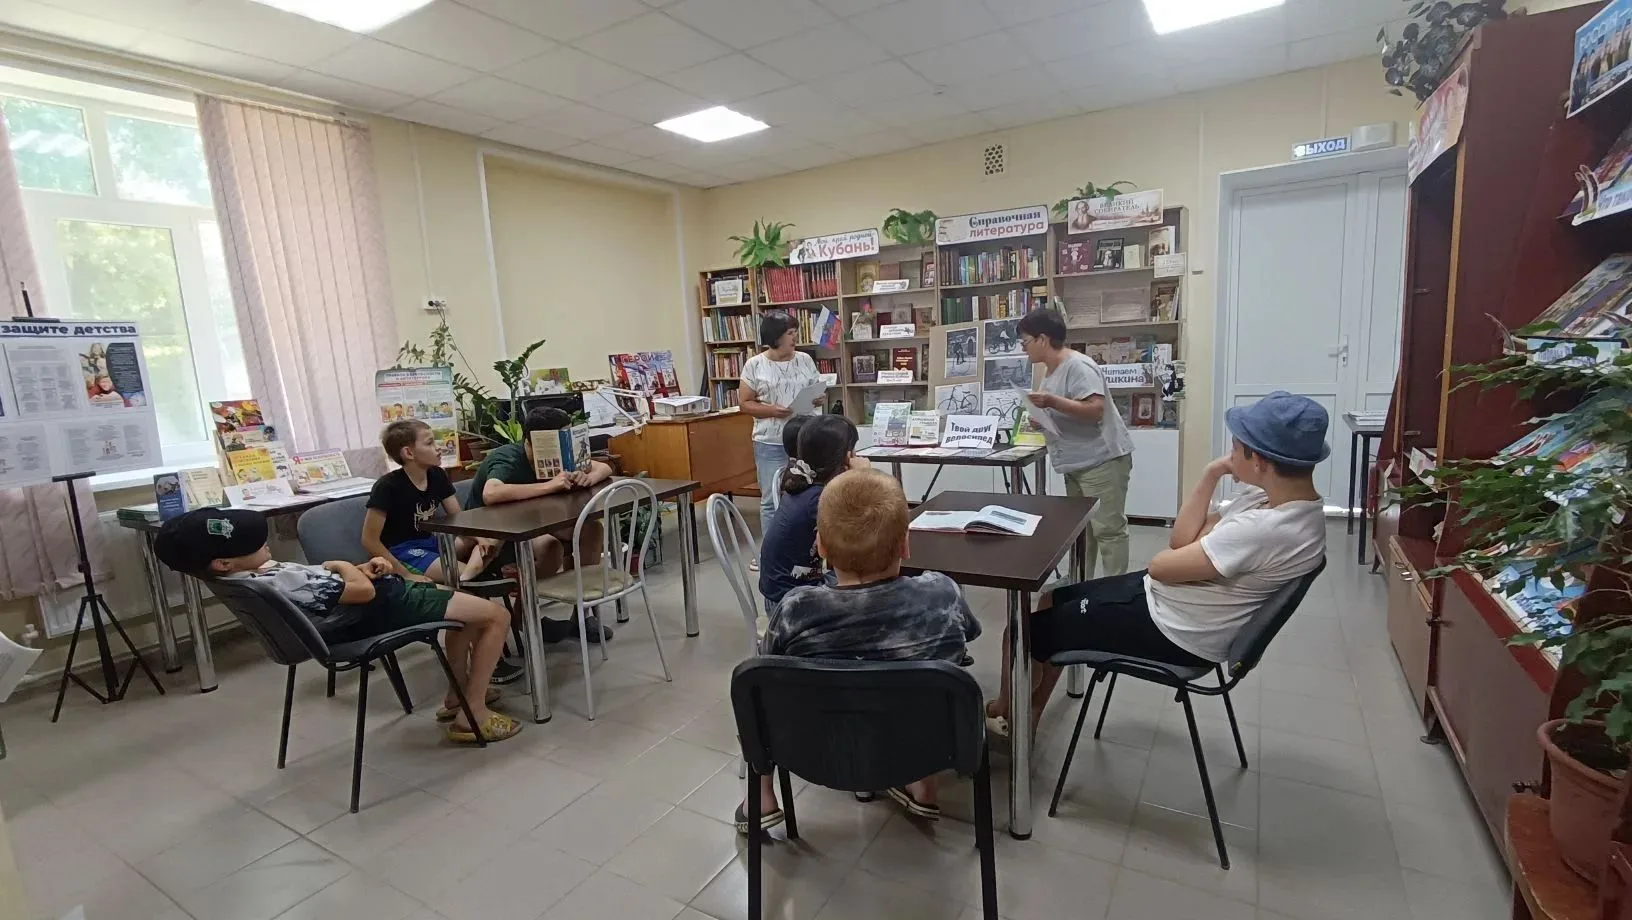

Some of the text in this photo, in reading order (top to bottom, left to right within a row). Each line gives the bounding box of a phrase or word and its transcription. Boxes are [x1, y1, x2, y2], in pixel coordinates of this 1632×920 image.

[969, 211, 1041, 228] Справочная
[970, 221, 1044, 238] литература
[819, 237, 875, 259] Кубань!
[1, 324, 137, 335] защите детства
[1101, 366, 1137, 376] Читаем
[951, 422, 992, 433] Твой друг
[945, 434, 993, 445] велосипед
